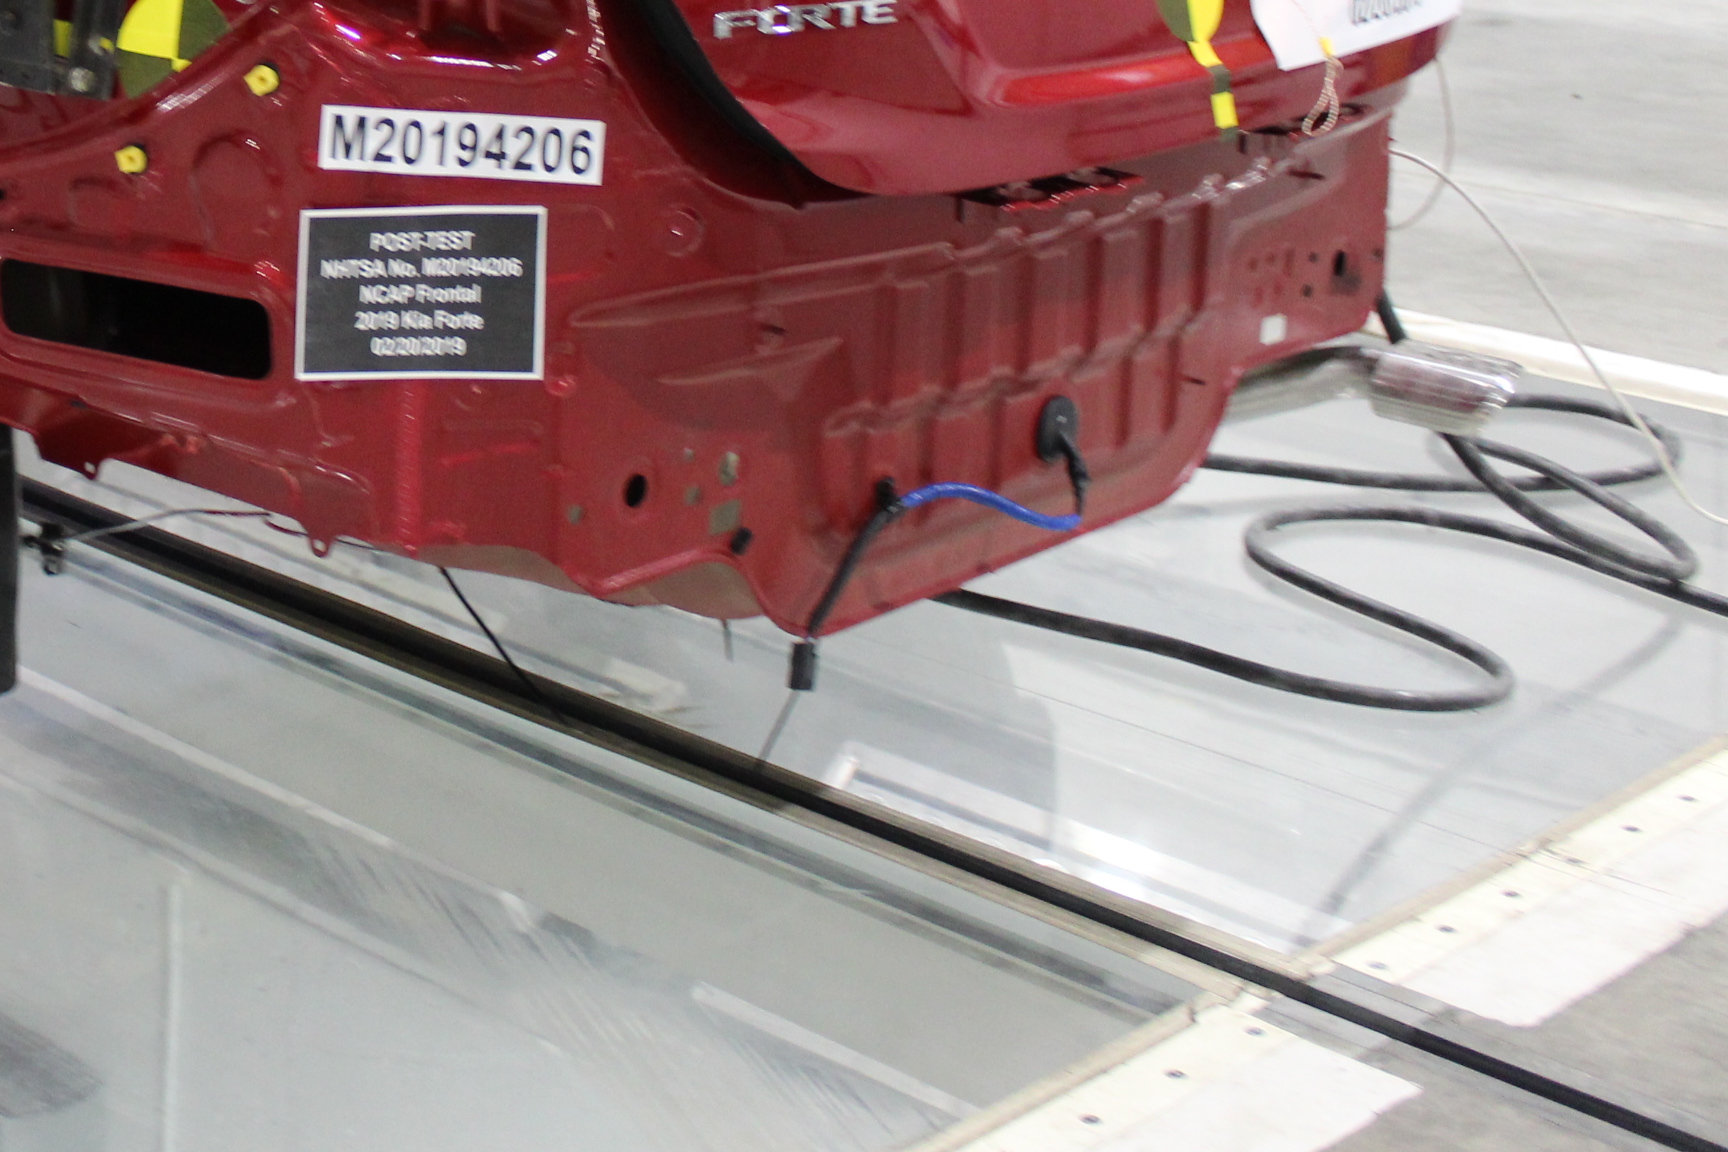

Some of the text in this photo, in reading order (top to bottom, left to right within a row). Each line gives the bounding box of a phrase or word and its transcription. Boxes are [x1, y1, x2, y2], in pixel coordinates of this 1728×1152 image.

[330, 114, 592, 175] M20194206
[369, 230, 476, 252] POST-TEST
[320, 257, 523, 279] NHTSA No. M20194206
[358, 283, 482, 304] NCAP Frontal
[353, 309, 485, 331] 2019 Kia Forte
